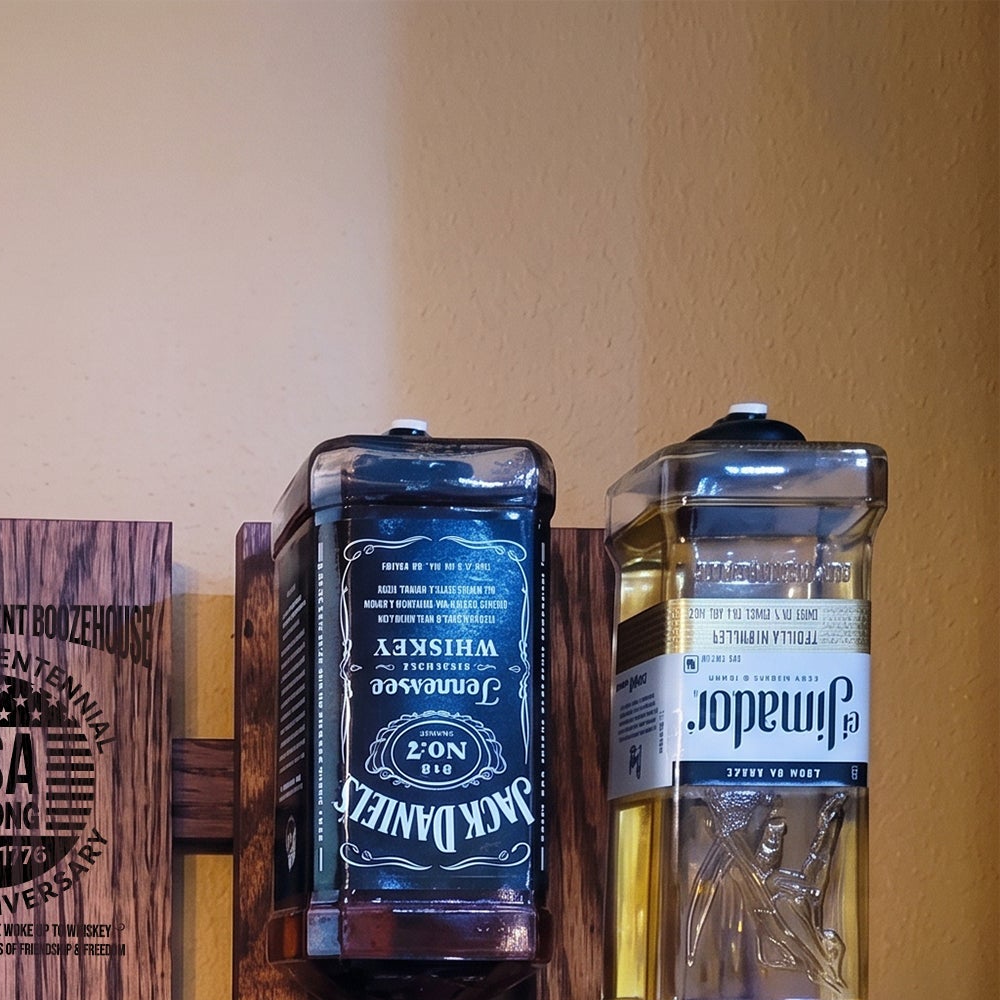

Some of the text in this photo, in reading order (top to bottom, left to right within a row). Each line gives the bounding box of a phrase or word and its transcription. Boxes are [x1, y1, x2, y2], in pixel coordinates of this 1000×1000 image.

[33, 605, 152, 670] BOOZEHOUSE
[373, 638, 499, 656] WHISKEY
[370, 677, 501, 706] Tennessee
[457, 776, 535, 842] JACK
[0, 846, 48, 867] 1776
[4, 924, 34, 937] WOKE
[5, 943, 18, 955] OF
